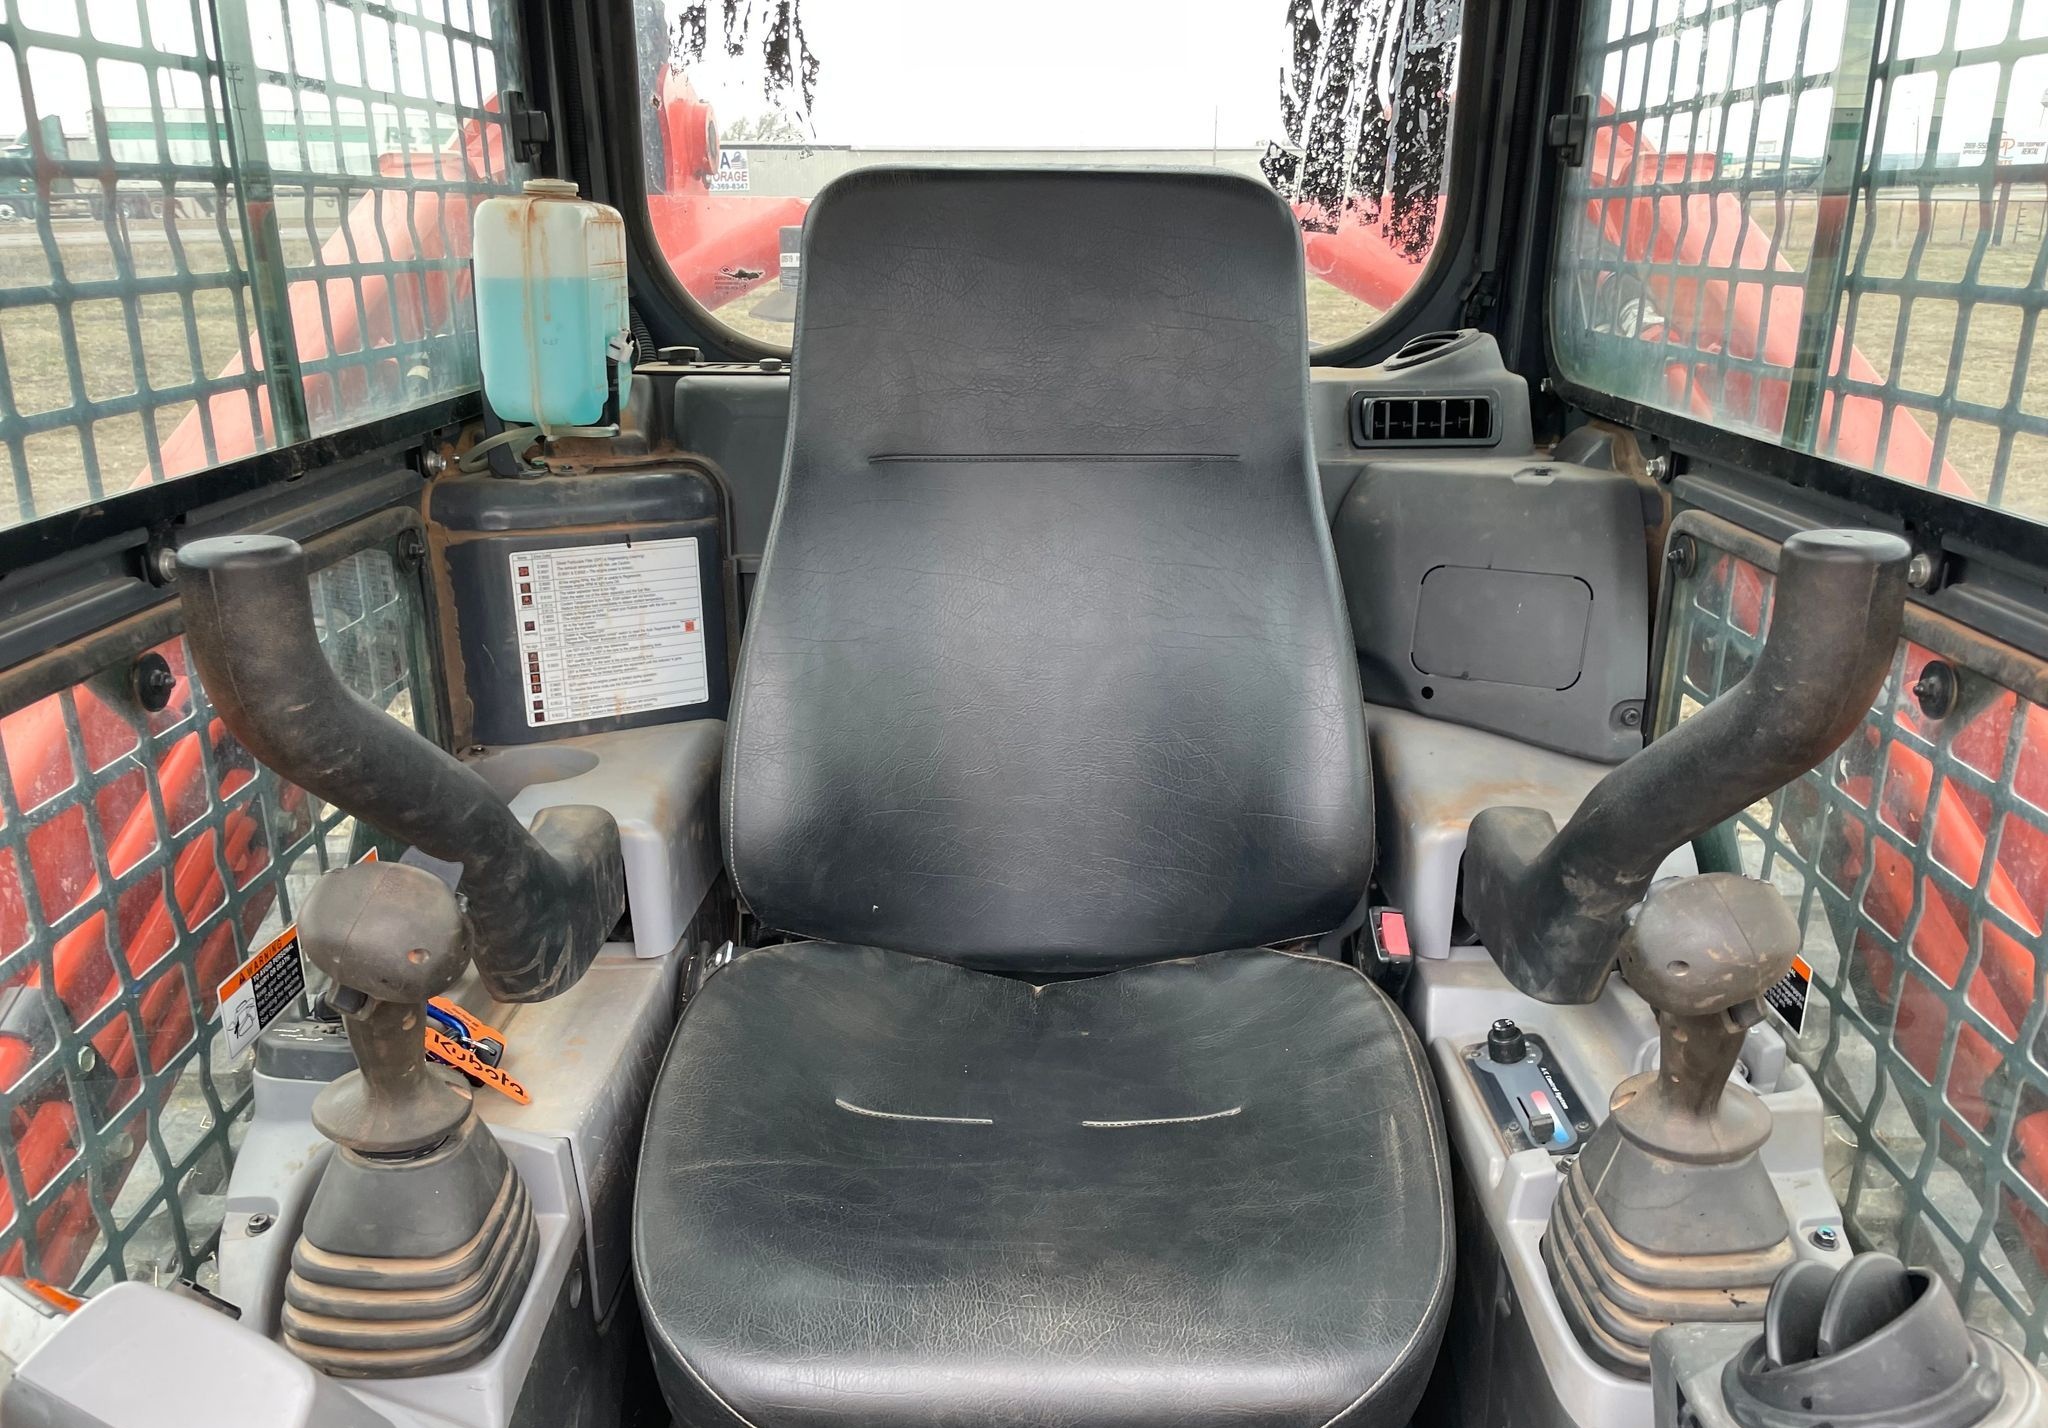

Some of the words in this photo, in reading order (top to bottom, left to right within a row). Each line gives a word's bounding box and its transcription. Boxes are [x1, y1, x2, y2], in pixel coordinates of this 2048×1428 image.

[713, 171, 748, 182] ORAGE
[246, 939, 282, 976] WARNING
[260, 962, 273, 976] AVOID
[434, 1034, 524, 1096] Kubota
